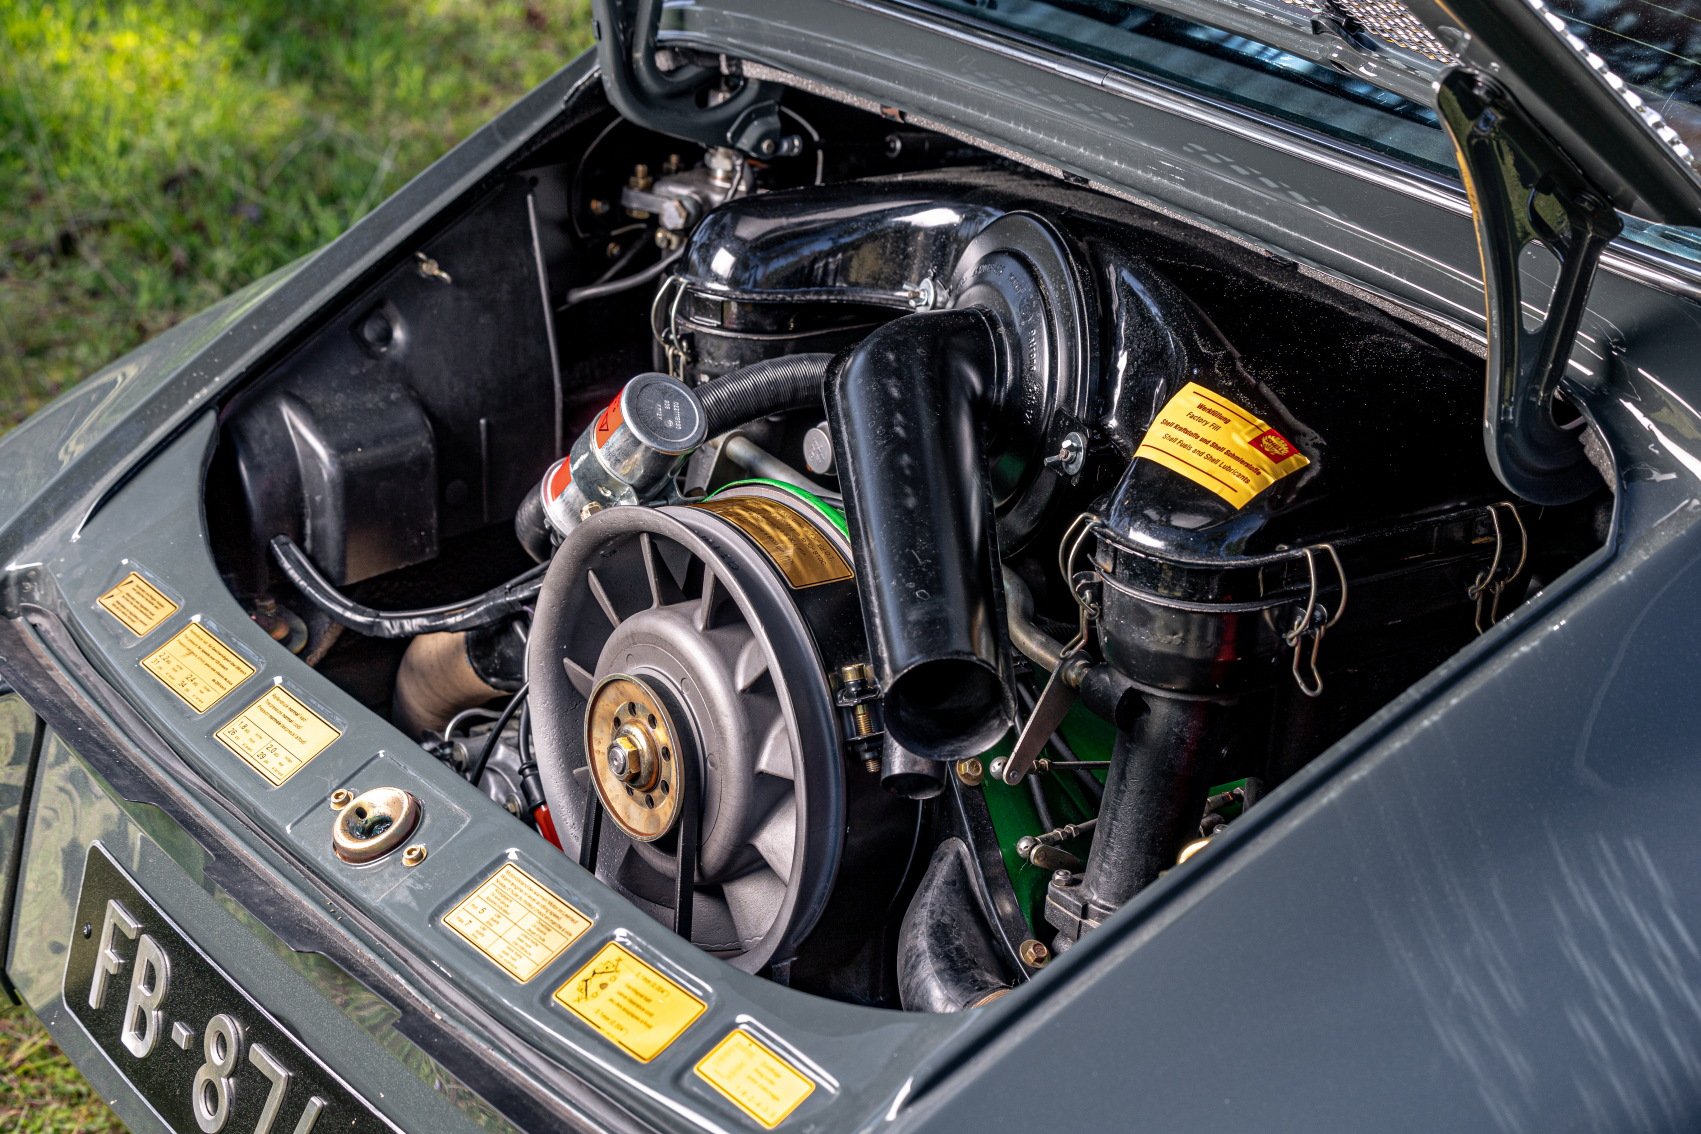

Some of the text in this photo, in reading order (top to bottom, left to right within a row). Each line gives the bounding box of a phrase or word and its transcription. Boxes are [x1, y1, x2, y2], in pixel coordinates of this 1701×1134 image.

[1186, 411, 1222, 432] Factory Fill
[1196, 402, 1231, 425] Werkfüllung
[1160, 418, 1262, 476] Shell Kraftstoffe und Shell Schmierstoffe
[1162, 433, 1251, 485] Shell Fuels and Shell Lubricants
[1265, 437, 1286, 455] SHELL
[88, 899, 327, 1134] FB-87
